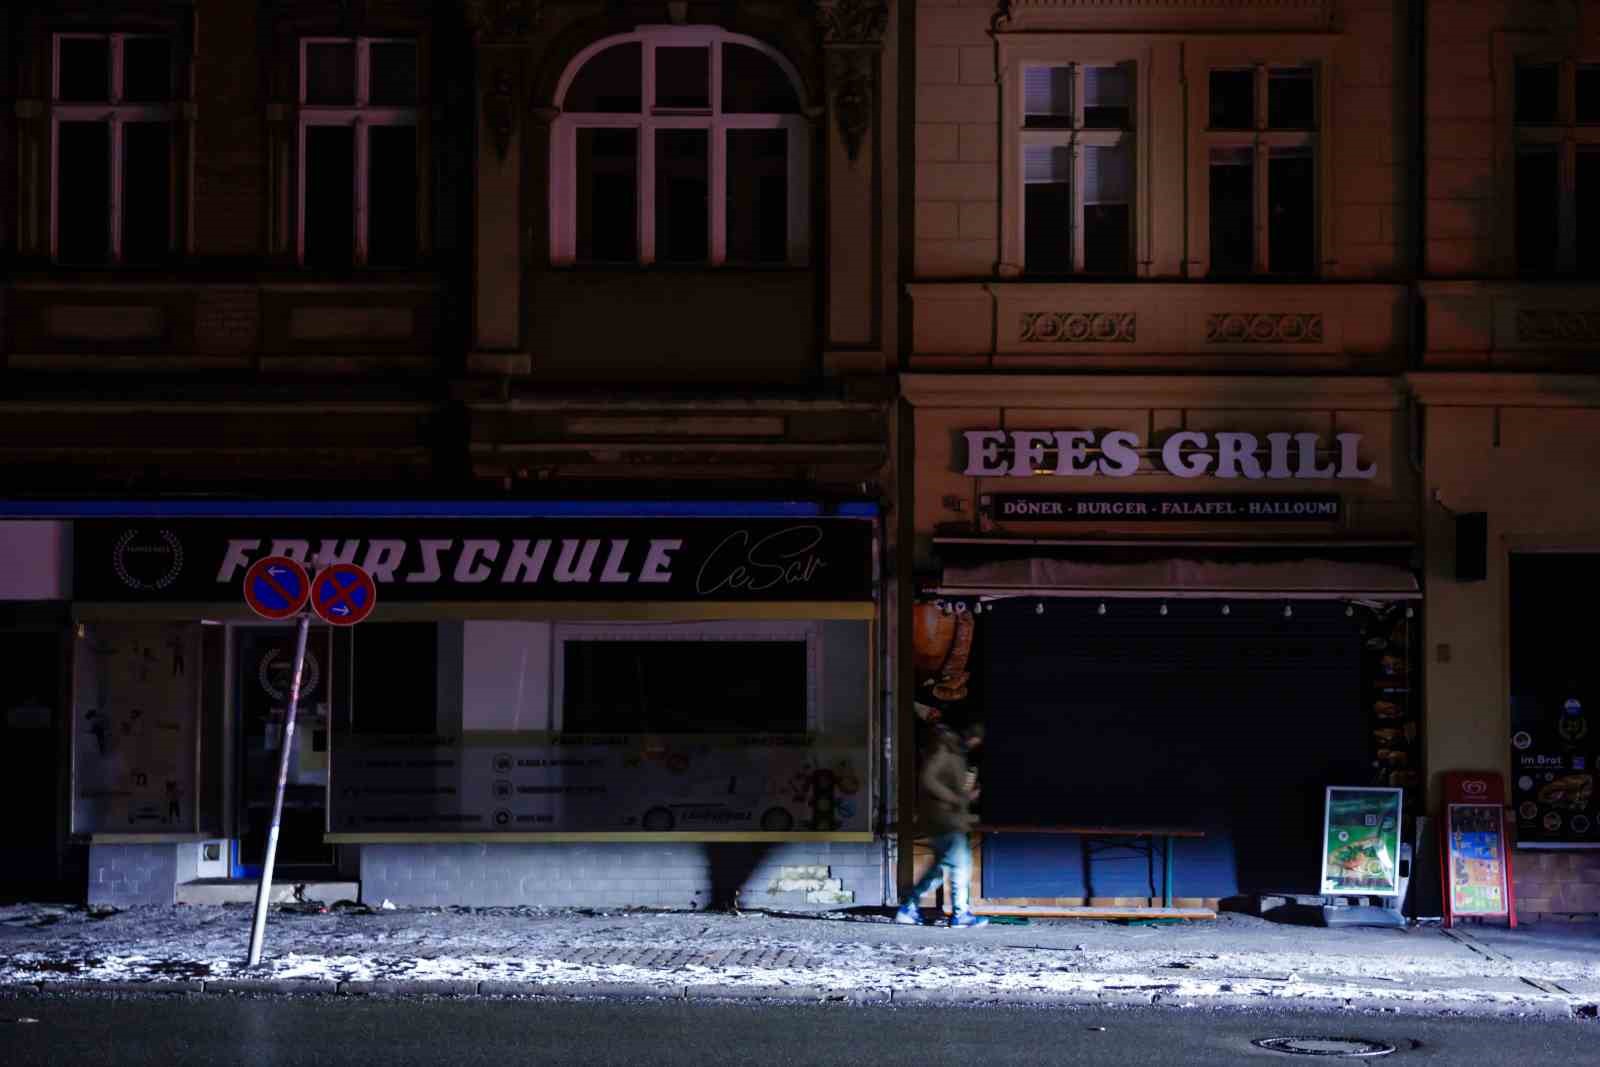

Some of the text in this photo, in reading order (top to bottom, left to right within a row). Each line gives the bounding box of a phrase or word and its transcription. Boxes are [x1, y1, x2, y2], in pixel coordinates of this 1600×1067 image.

[962, 429, 1378, 480] EFES GRILL
[1003, 499, 1064, 515] DÖNER
[1076, 501, 1148, 515] BURGER
[1161, 501, 1234, 515] FALAFEL
[1249, 501, 1338, 515] HALLOUMI
